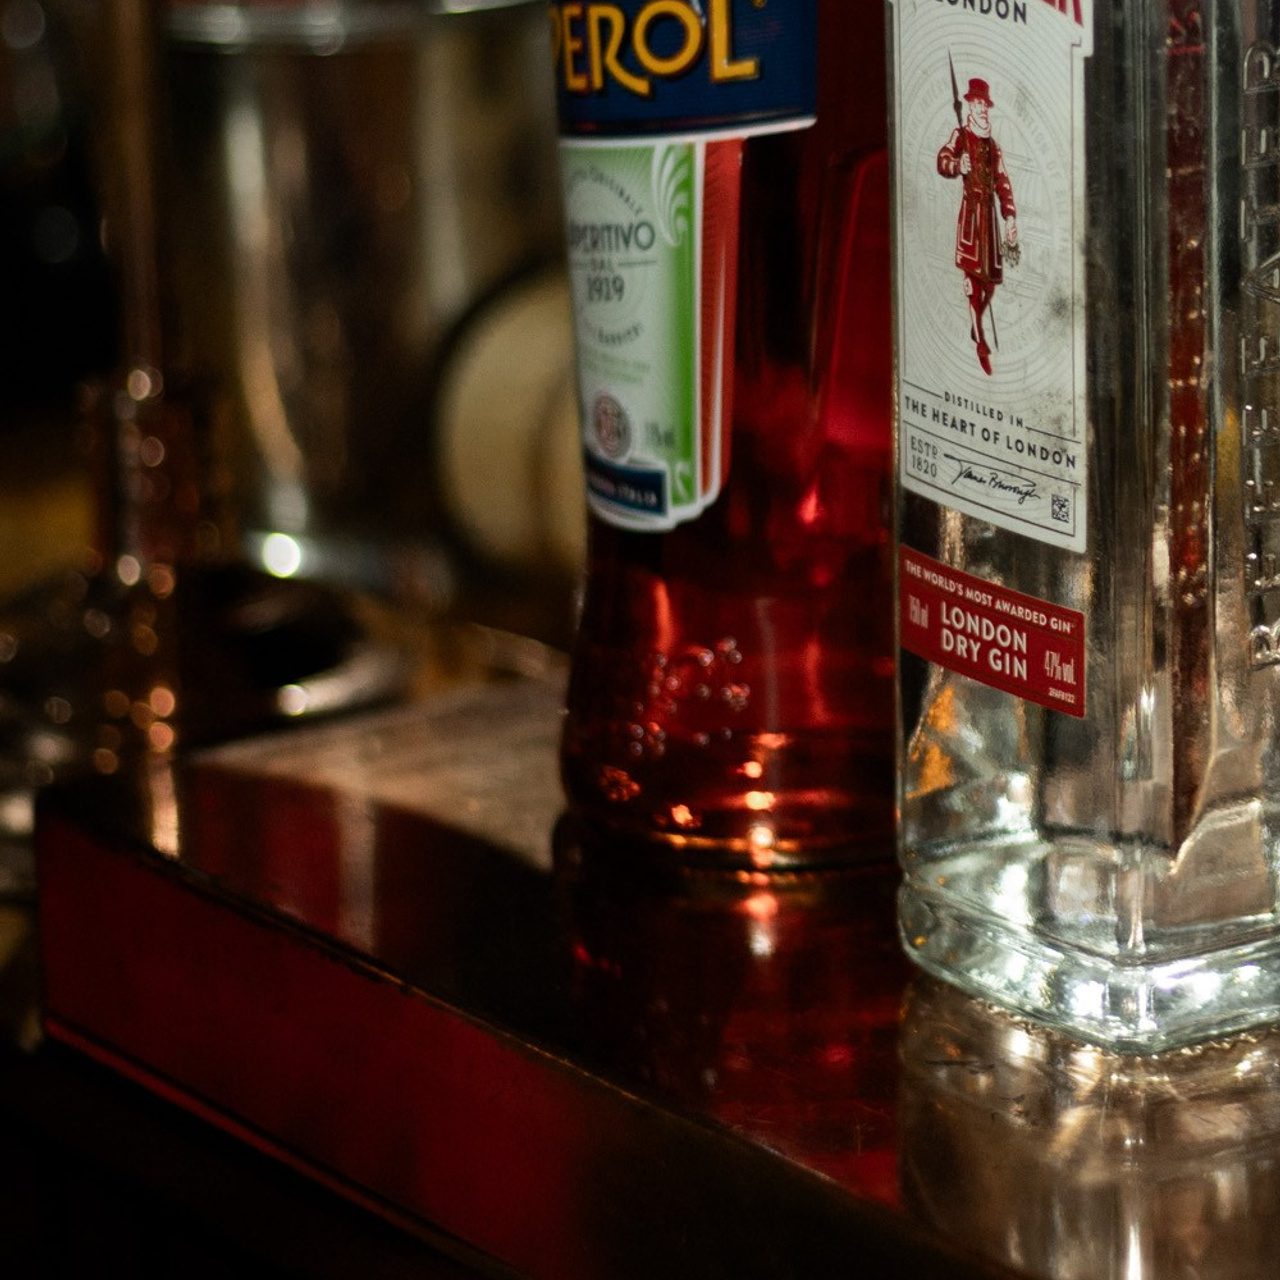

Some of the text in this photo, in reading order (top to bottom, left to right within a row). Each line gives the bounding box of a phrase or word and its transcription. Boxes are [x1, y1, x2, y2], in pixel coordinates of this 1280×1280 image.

[904, 395, 1077, 469] THE HEART OF LONDON
[944, 391, 1024, 429] DISTILLED IN
[911, 454, 938, 479] 1820
[905, 559, 1072, 635] THE WORLD'S MOST AWARDED GIN
[941, 600, 1027, 655] LONDON
[941, 627, 1027, 682] DRY GIN
